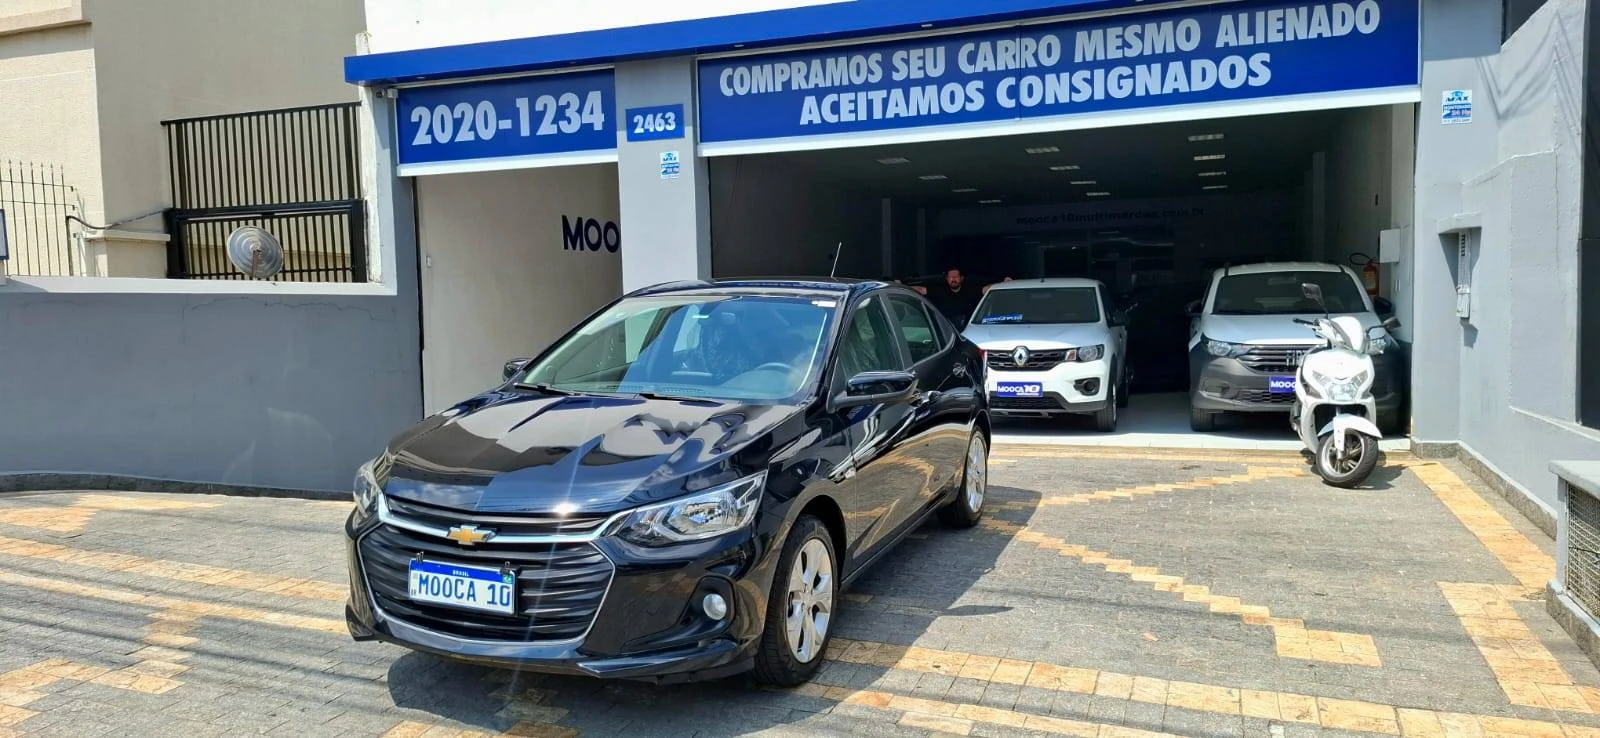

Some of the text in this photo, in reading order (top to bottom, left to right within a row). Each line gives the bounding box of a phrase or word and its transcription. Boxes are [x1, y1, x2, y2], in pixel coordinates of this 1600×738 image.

[719, 0, 1381, 97] COMPRAMOS SEU CARRO MESMO ALIENADO
[799, 52, 1272, 126] ACEITAMOS CONSIGNADOS
[410, 90, 605, 146] 2020-1234
[633, 111, 676, 134] 2463
[418, 573, 511, 607] MOOCA 10
[452, 569, 470, 577] BRASIL
